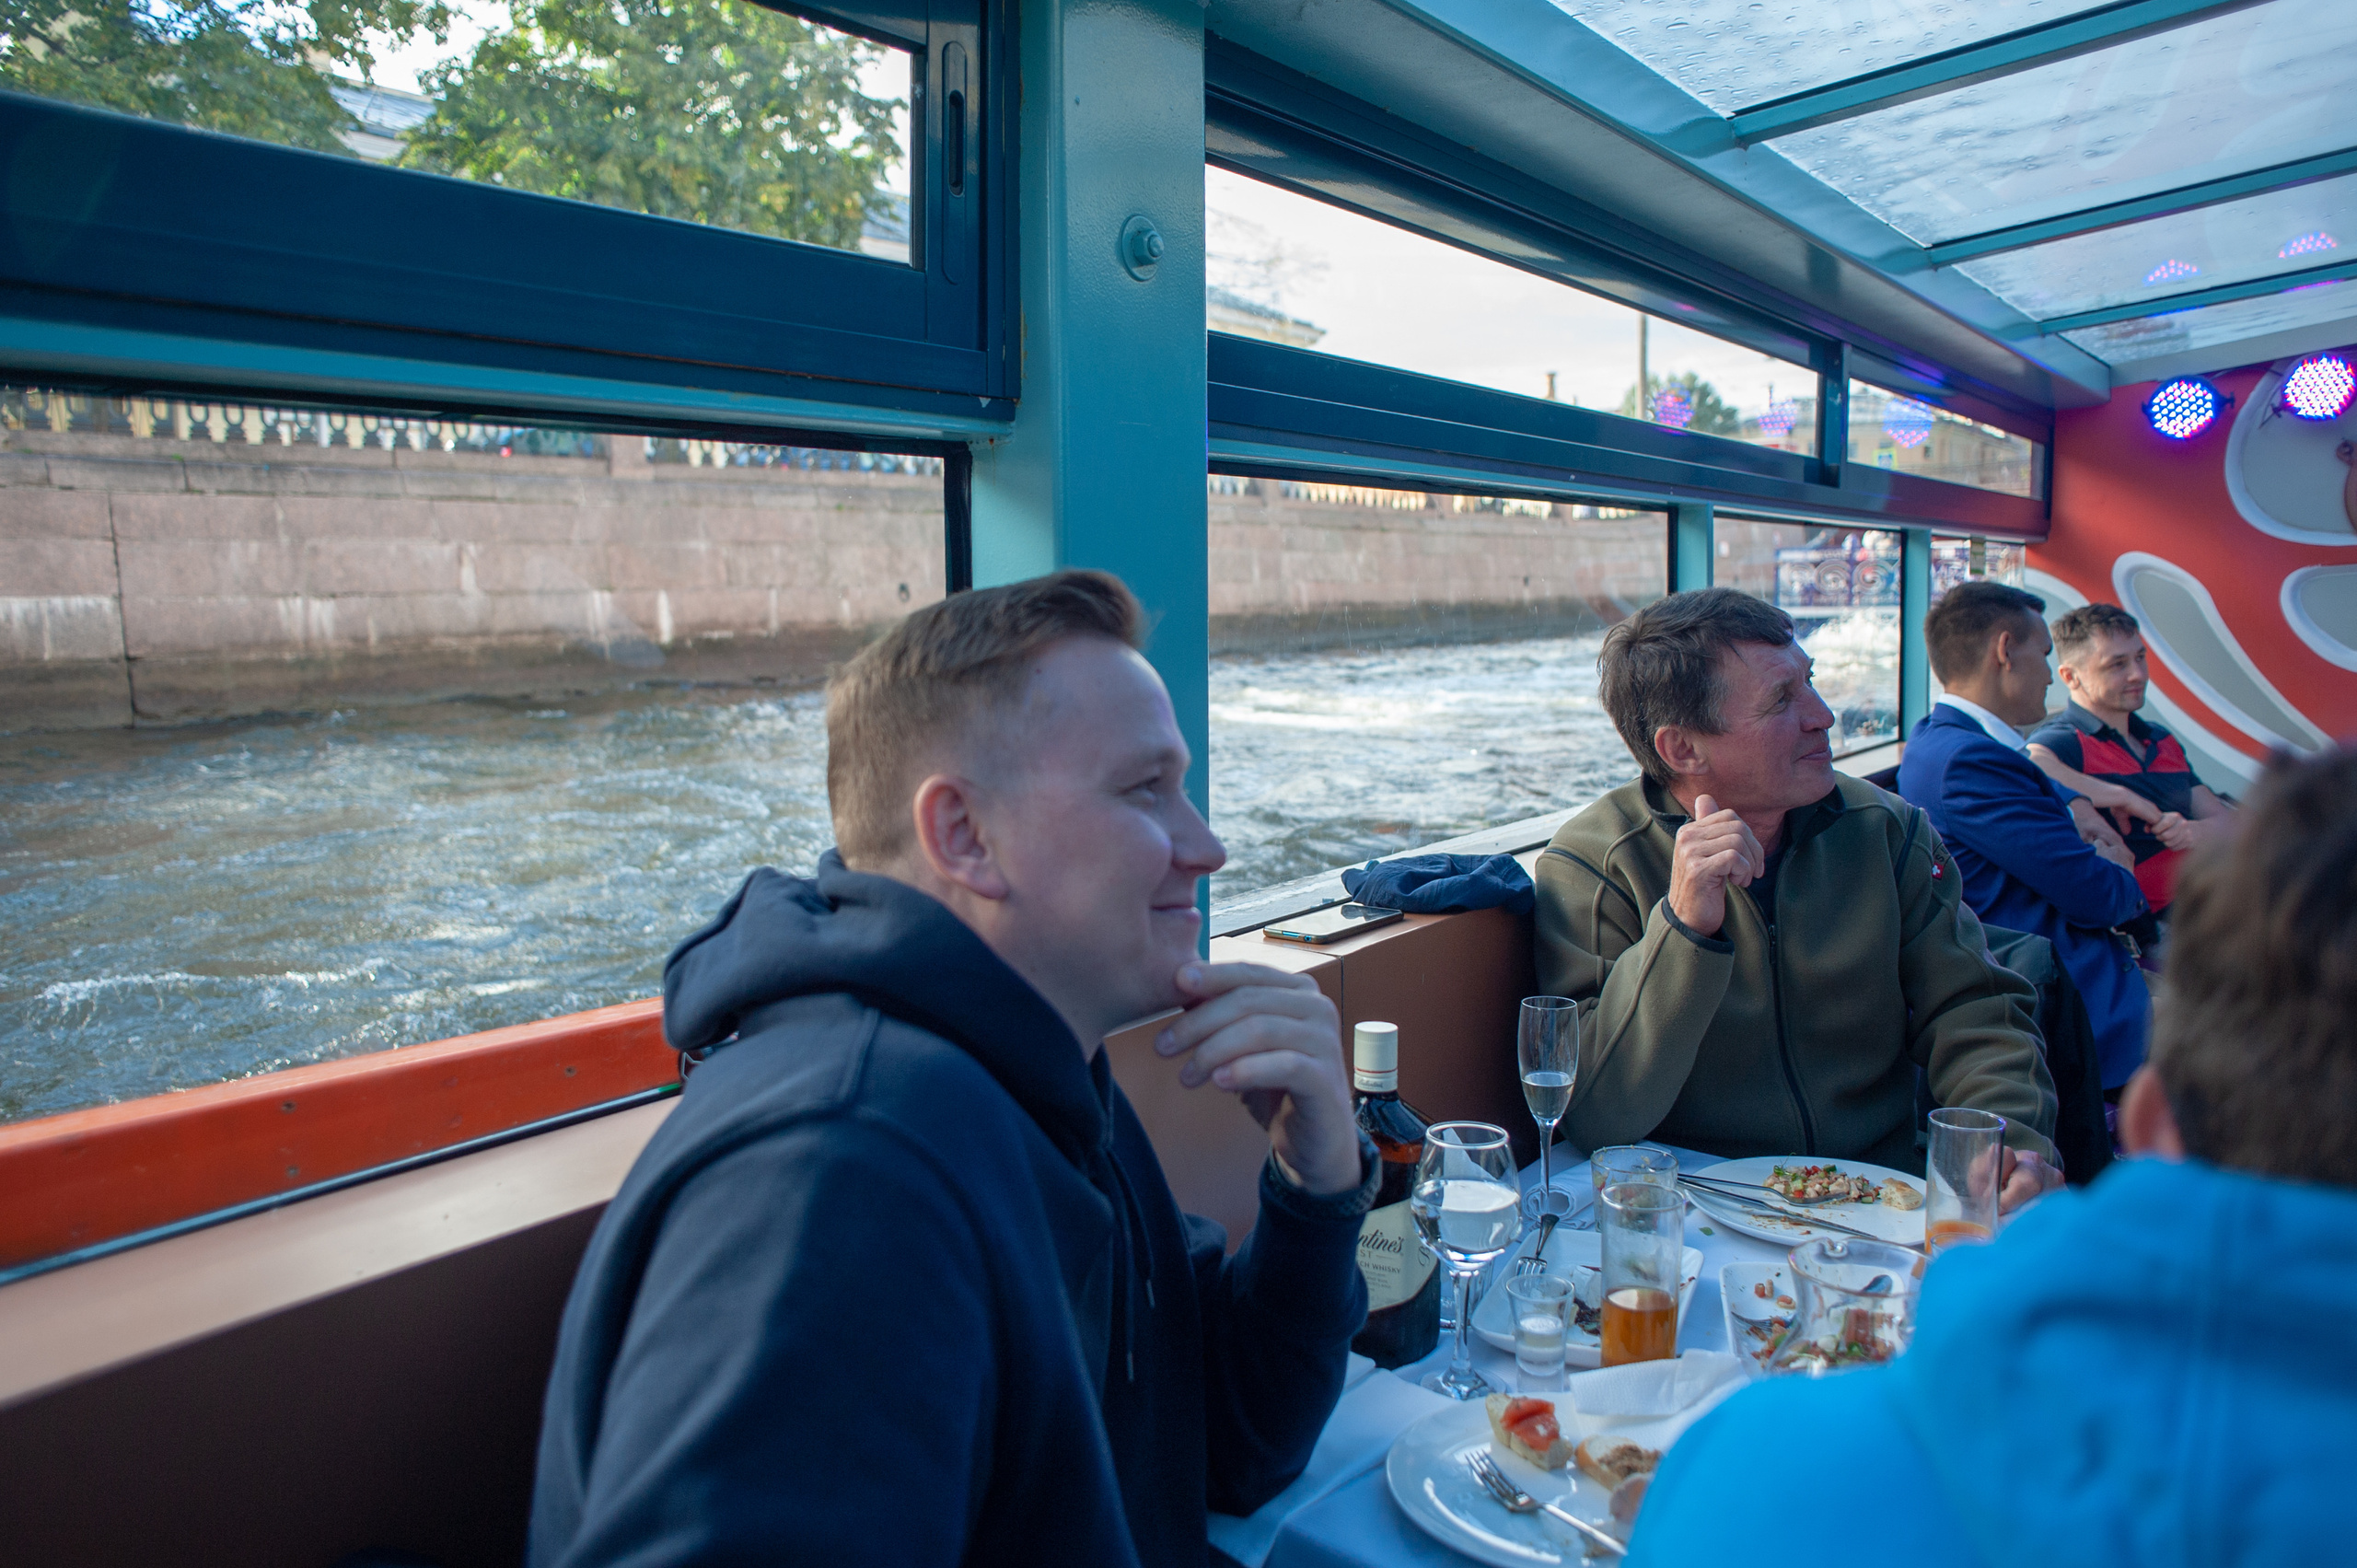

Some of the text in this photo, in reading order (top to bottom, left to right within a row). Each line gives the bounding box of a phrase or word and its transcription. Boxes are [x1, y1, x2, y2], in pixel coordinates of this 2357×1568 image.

[1357, 1229, 1405, 1253] ntine's
[1359, 1260, 1371, 1269] CH
[1372, 1262, 1401, 1274] WHISKY
